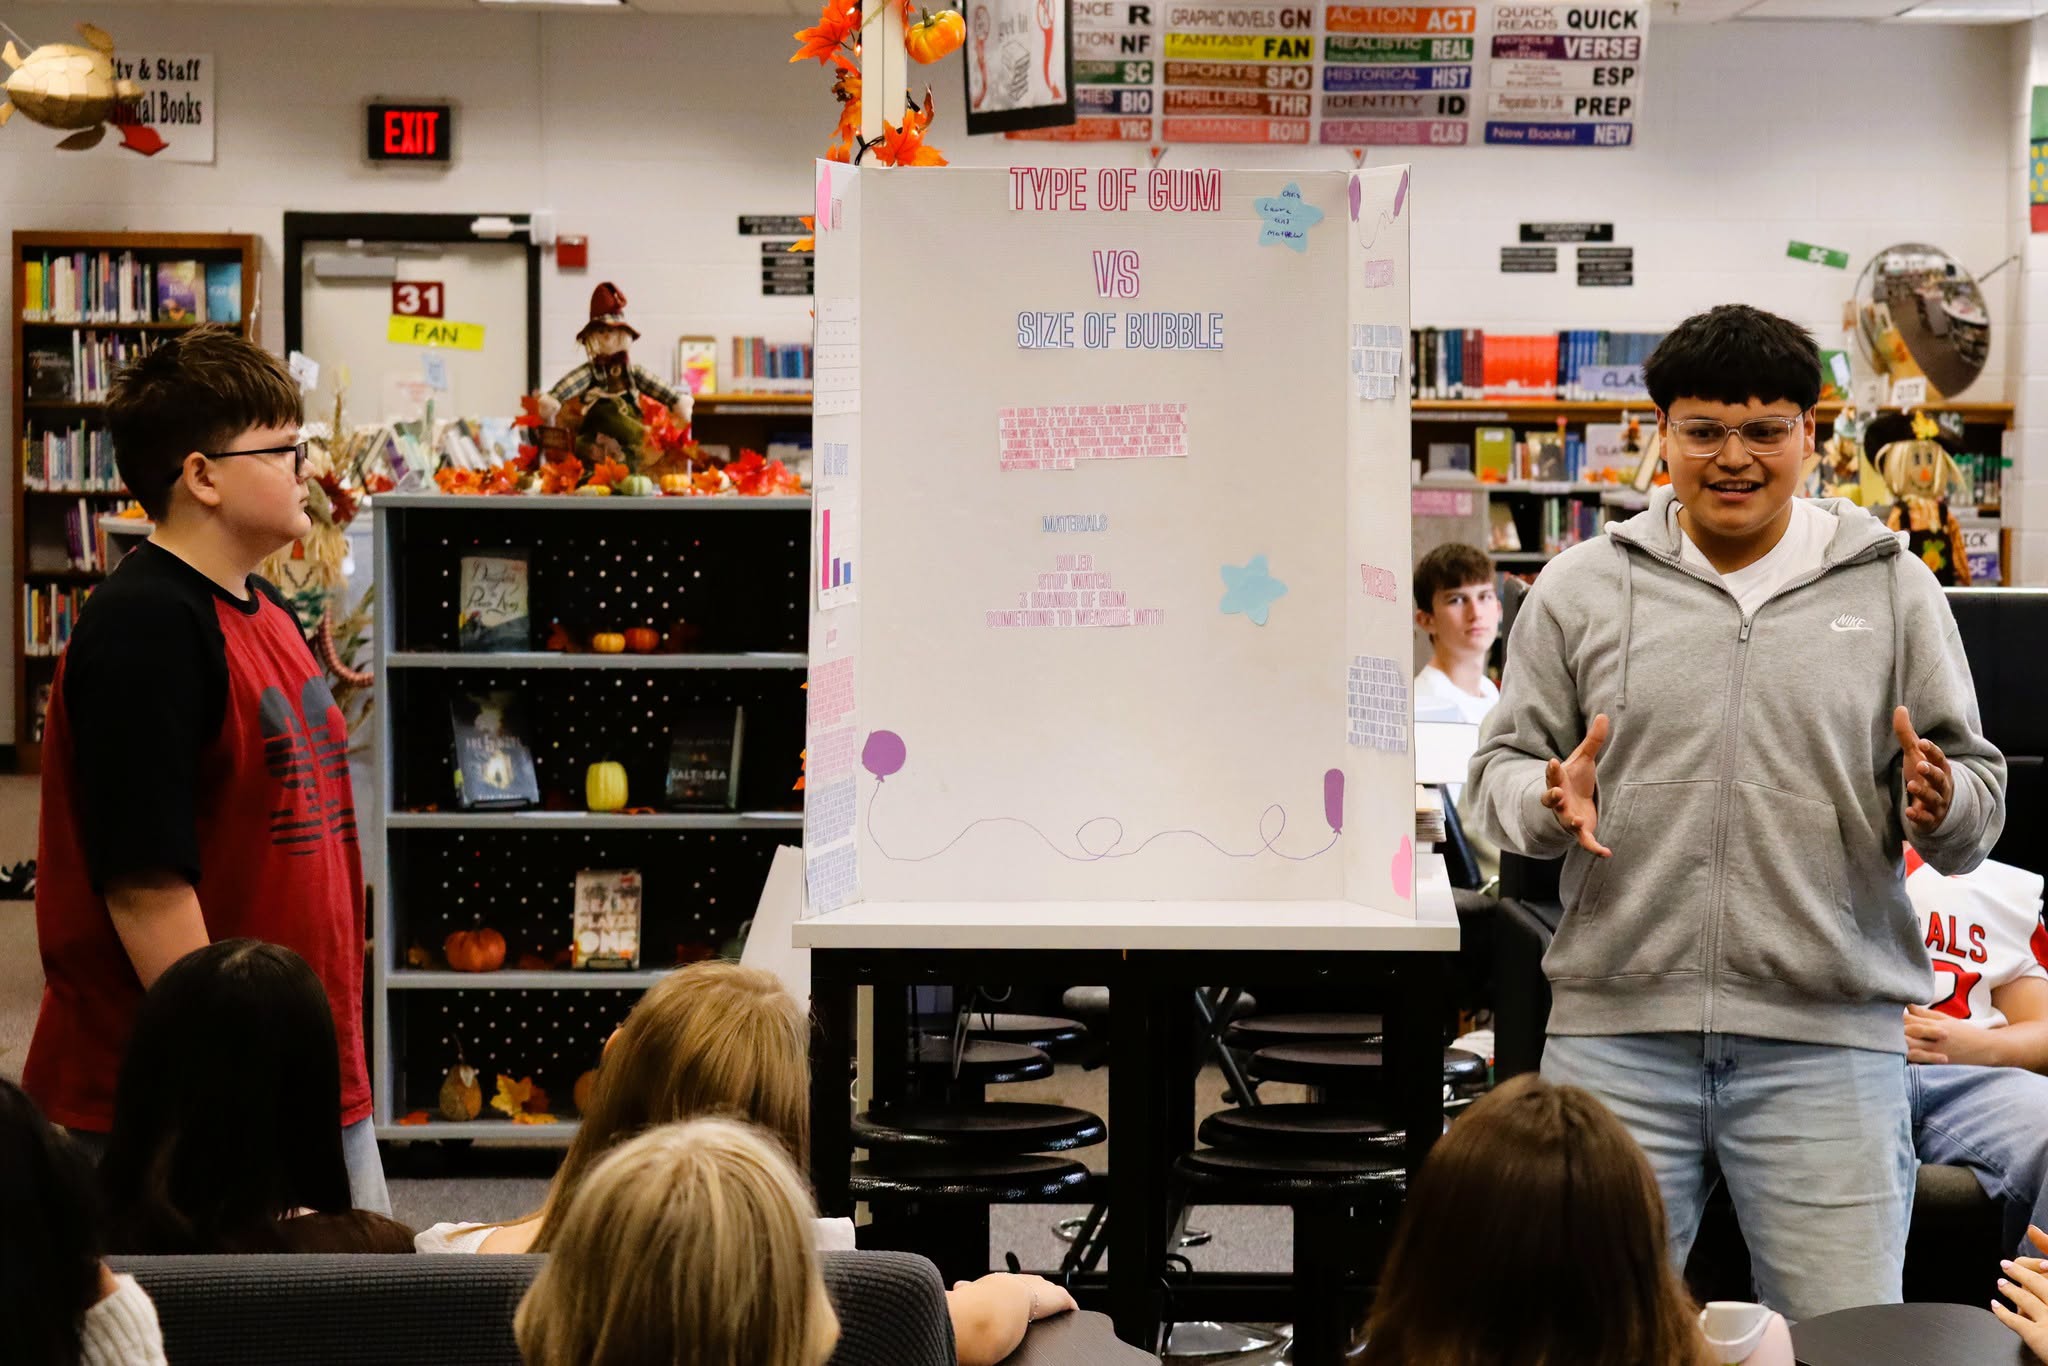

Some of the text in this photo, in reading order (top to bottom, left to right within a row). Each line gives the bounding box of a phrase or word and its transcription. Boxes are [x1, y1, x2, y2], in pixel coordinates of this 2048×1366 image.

[1128, 5, 1151, 25] R
[1171, 9, 1275, 28] GRAPHIC NOVELS
[1279, 8, 1311, 28] GN
[1330, 7, 1417, 25] ACTION
[1426, 9, 1473, 31] ACT
[1497, 7, 1554, 18] QUICK
[1566, 9, 1639, 30] QUICK
[1497, 19, 1558, 30] READS
[1120, 35, 1151, 54] NF
[1170, 33, 1257, 46] FANTASY
[1263, 38, 1310, 58] FAN
[1329, 37, 1422, 50] REALISTIC
[1431, 39, 1470, 60] REAL
[1563, 37, 1639, 59] VERSE
[157, 58, 200, 81] Staff
[1124, 62, 1151, 82] SC
[1167, 63, 1261, 79] SPORTS
[1265, 66, 1310, 89] SPO
[1326, 68, 1420, 81] HISTORICAL
[1431, 67, 1469, 88] HIST
[1593, 66, 1635, 86] ESP
[160, 90, 202, 125] Books
[1120, 90, 1151, 112] BIO
[1168, 91, 1259, 106] THRILLERS
[1267, 95, 1309, 116] THR
[1326, 95, 1424, 109] IDENTITY
[1437, 96, 1466, 115] ID
[1575, 96, 1632, 116] PREP
[384, 111, 439, 155] EXIT
[1268, 122, 1306, 141] ROM
[1429, 122, 1464, 143] CLAS
[1492, 126, 1576, 140] New Books!
[1594, 124, 1631, 144] NEW
[1010, 167, 1221, 212] TYPE OF GUM
[1093, 249, 1140, 299] VS
[397, 284, 440, 314] 31
[413, 322, 459, 344] FAN
[1017, 311, 1224, 349] SIZE OF BUBBLE
[1051, 407, 1067, 416] TYPE
[1042, 513, 1107, 532] MATERIALS
[1963, 532, 1987, 547] ICK
[1056, 554, 1093, 571] RULER
[1038, 573, 1112, 590] STOP WATCH
[1019, 591, 1127, 608] 3 BRANDS OF GUM
[985, 608, 1166, 627] SOMETHING TO MEASURE WITH
[1837, 613, 1867, 627] NIKE
[1924, 911, 1988, 964] ALS
